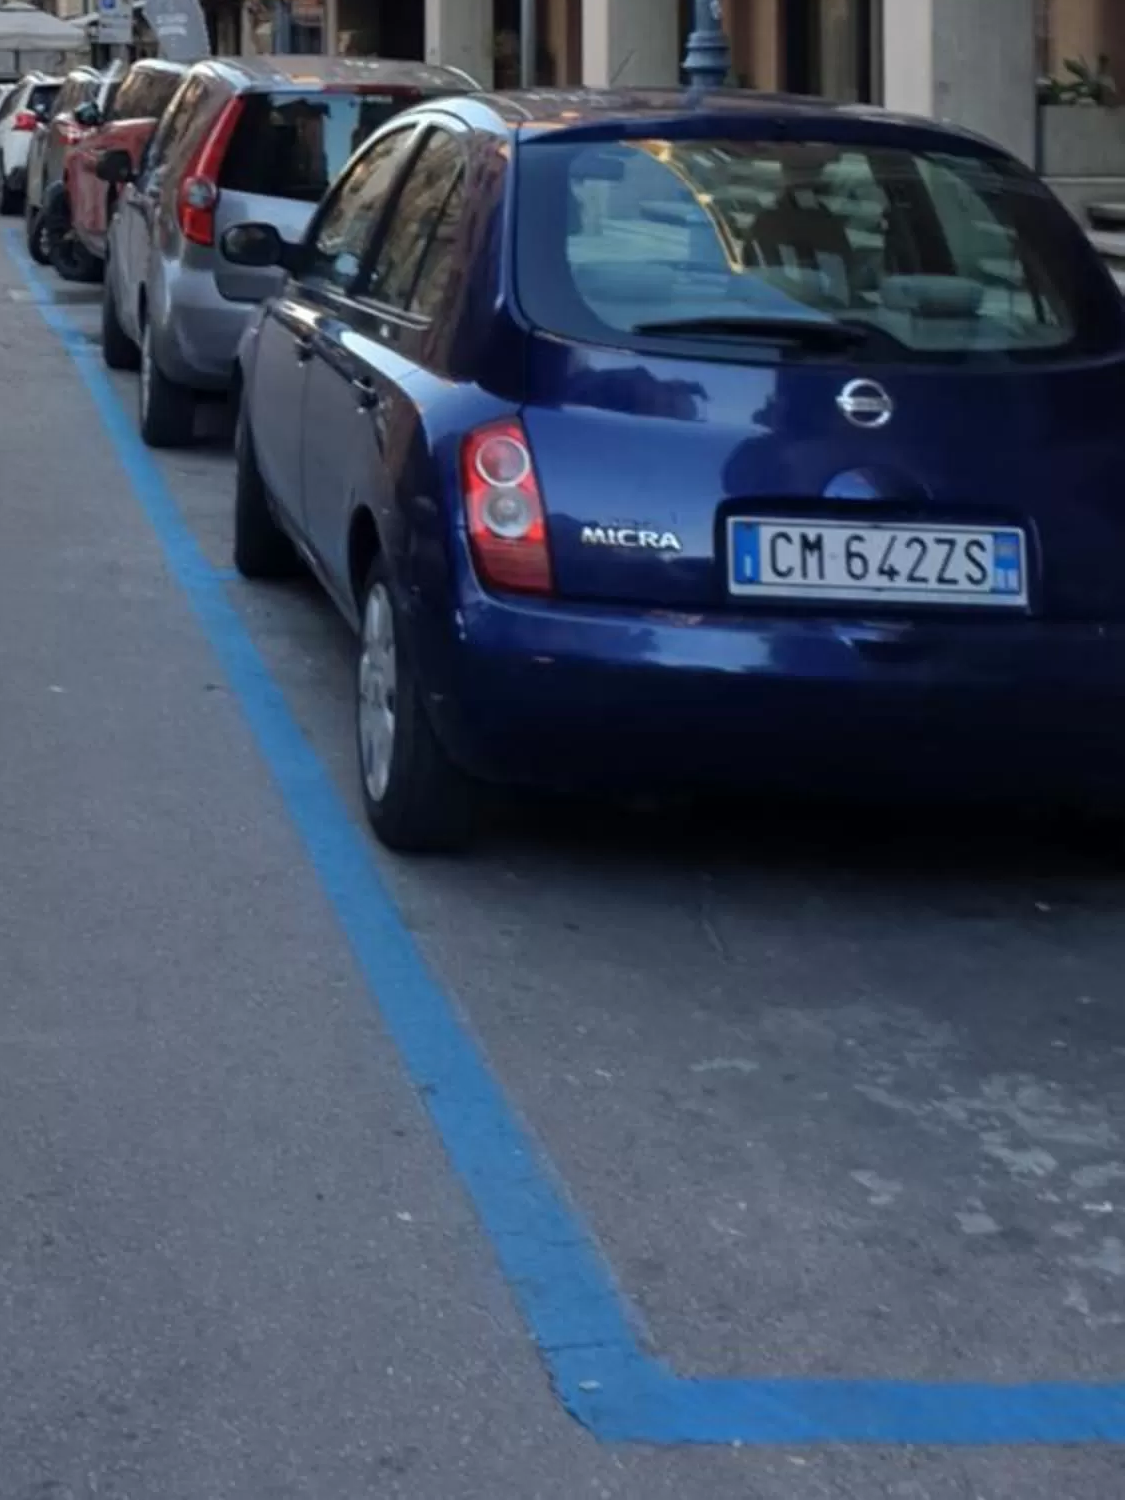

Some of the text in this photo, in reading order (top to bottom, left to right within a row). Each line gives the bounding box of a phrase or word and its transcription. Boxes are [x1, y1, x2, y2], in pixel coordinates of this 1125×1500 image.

[581, 526, 681, 550] MICRA
[770, 531, 988, 586] CM 642ZS
